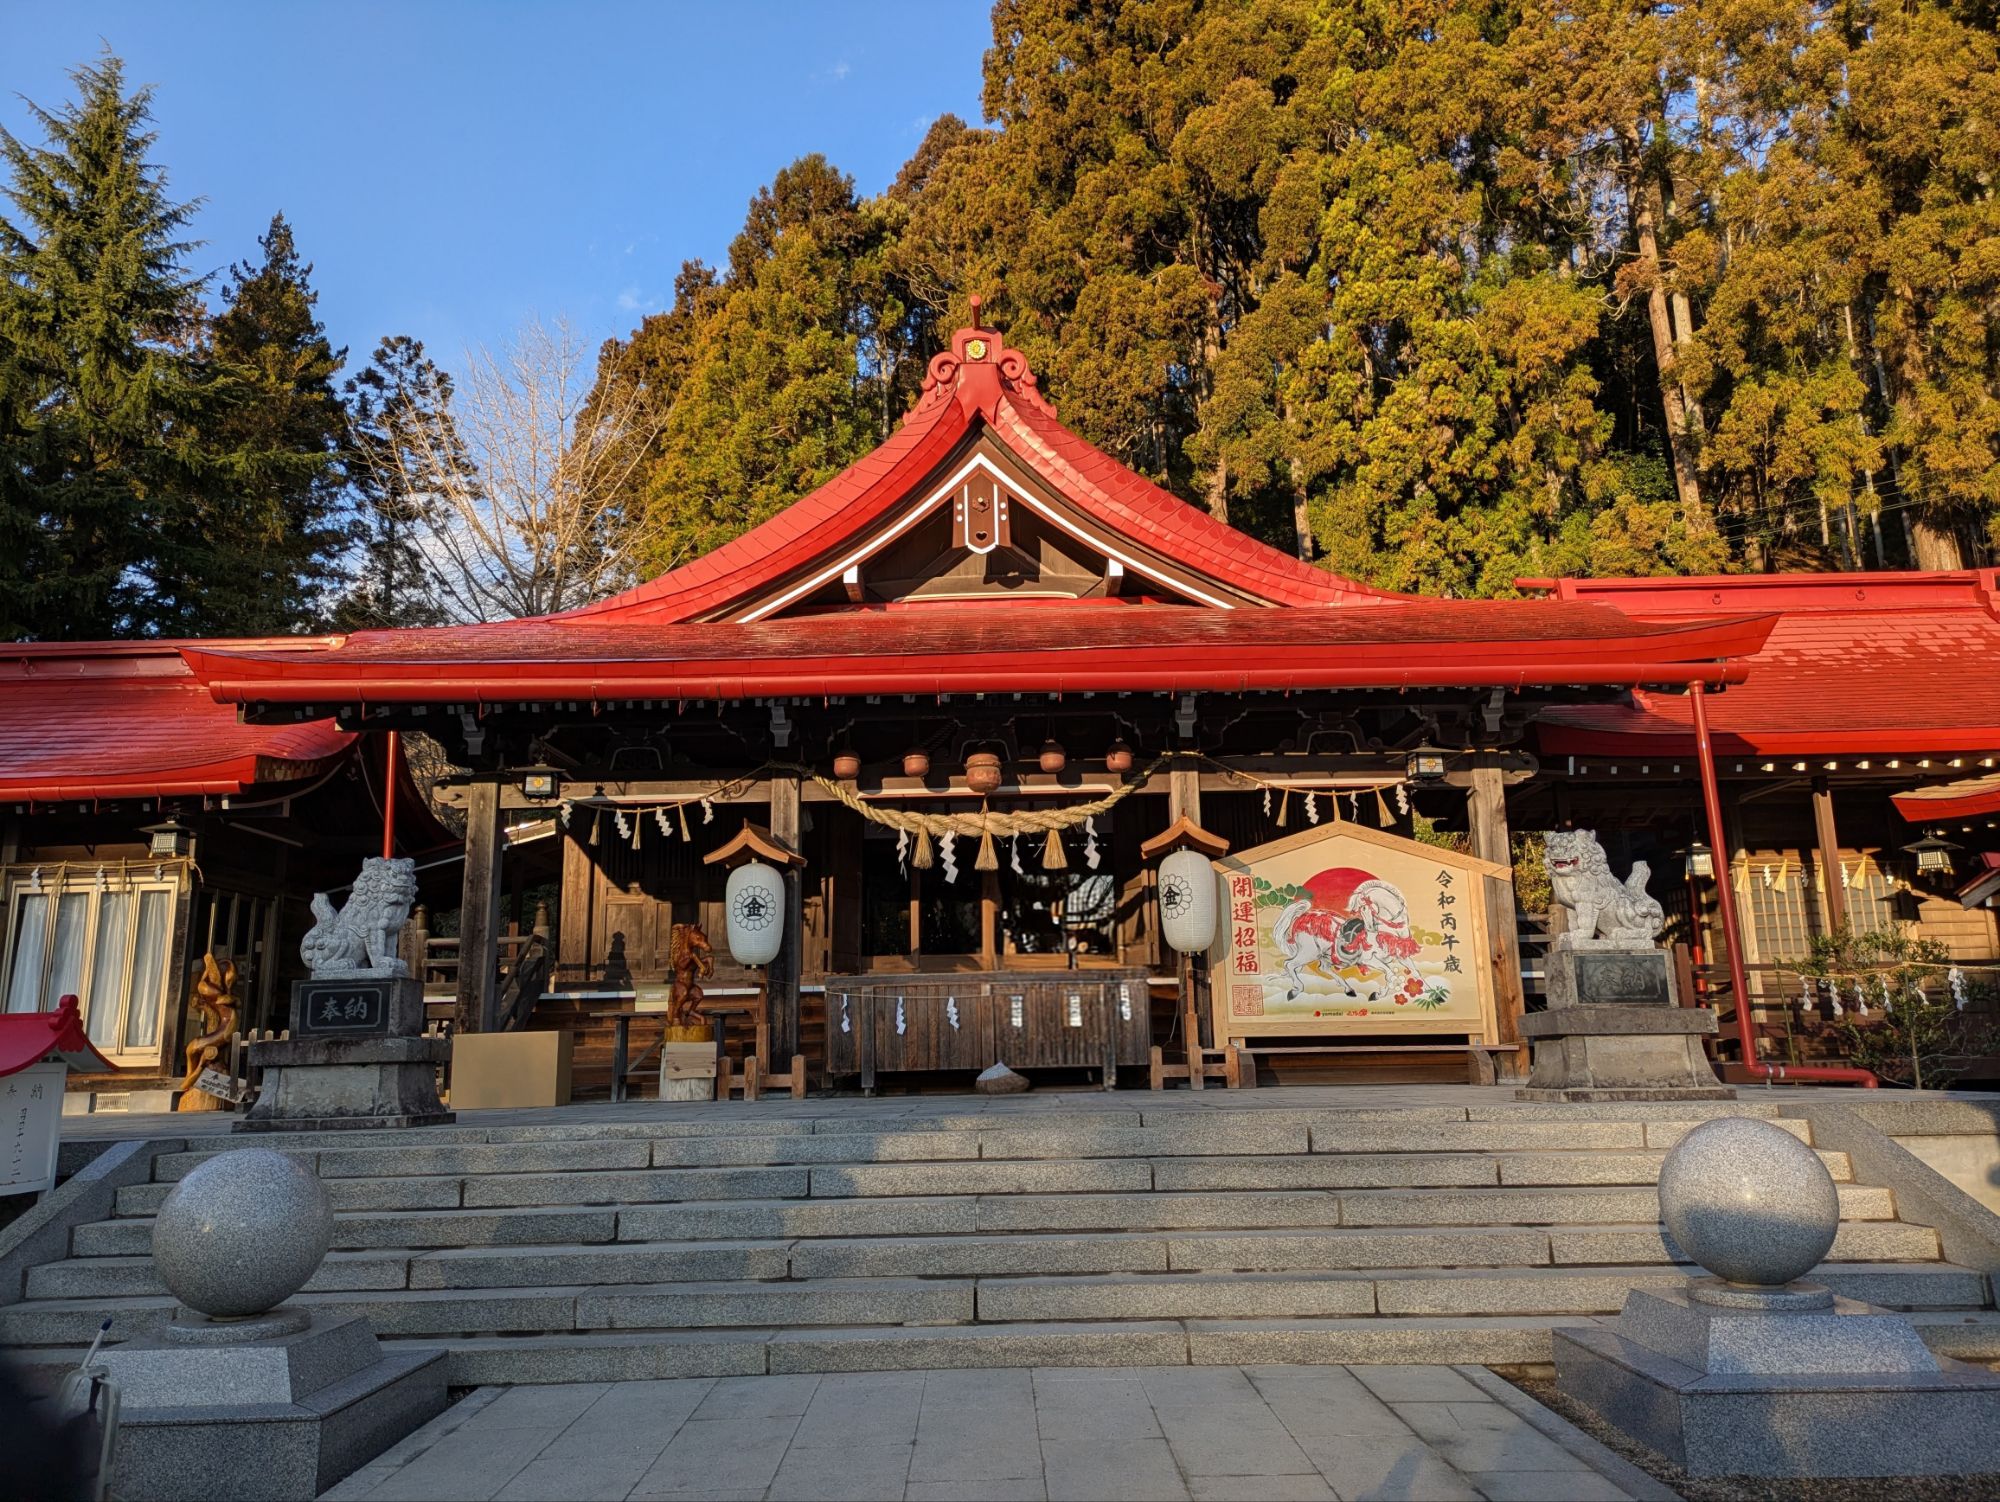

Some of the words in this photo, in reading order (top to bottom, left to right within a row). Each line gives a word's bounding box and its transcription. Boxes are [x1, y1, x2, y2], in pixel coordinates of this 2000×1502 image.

[744, 897, 765, 917] 金
[1163, 886, 1180, 906] 金
[1232, 876, 1258, 973] 開運招福
[1435, 870, 1462, 974] 令和丙午歳
[319, 996, 368, 1022] 奉納
